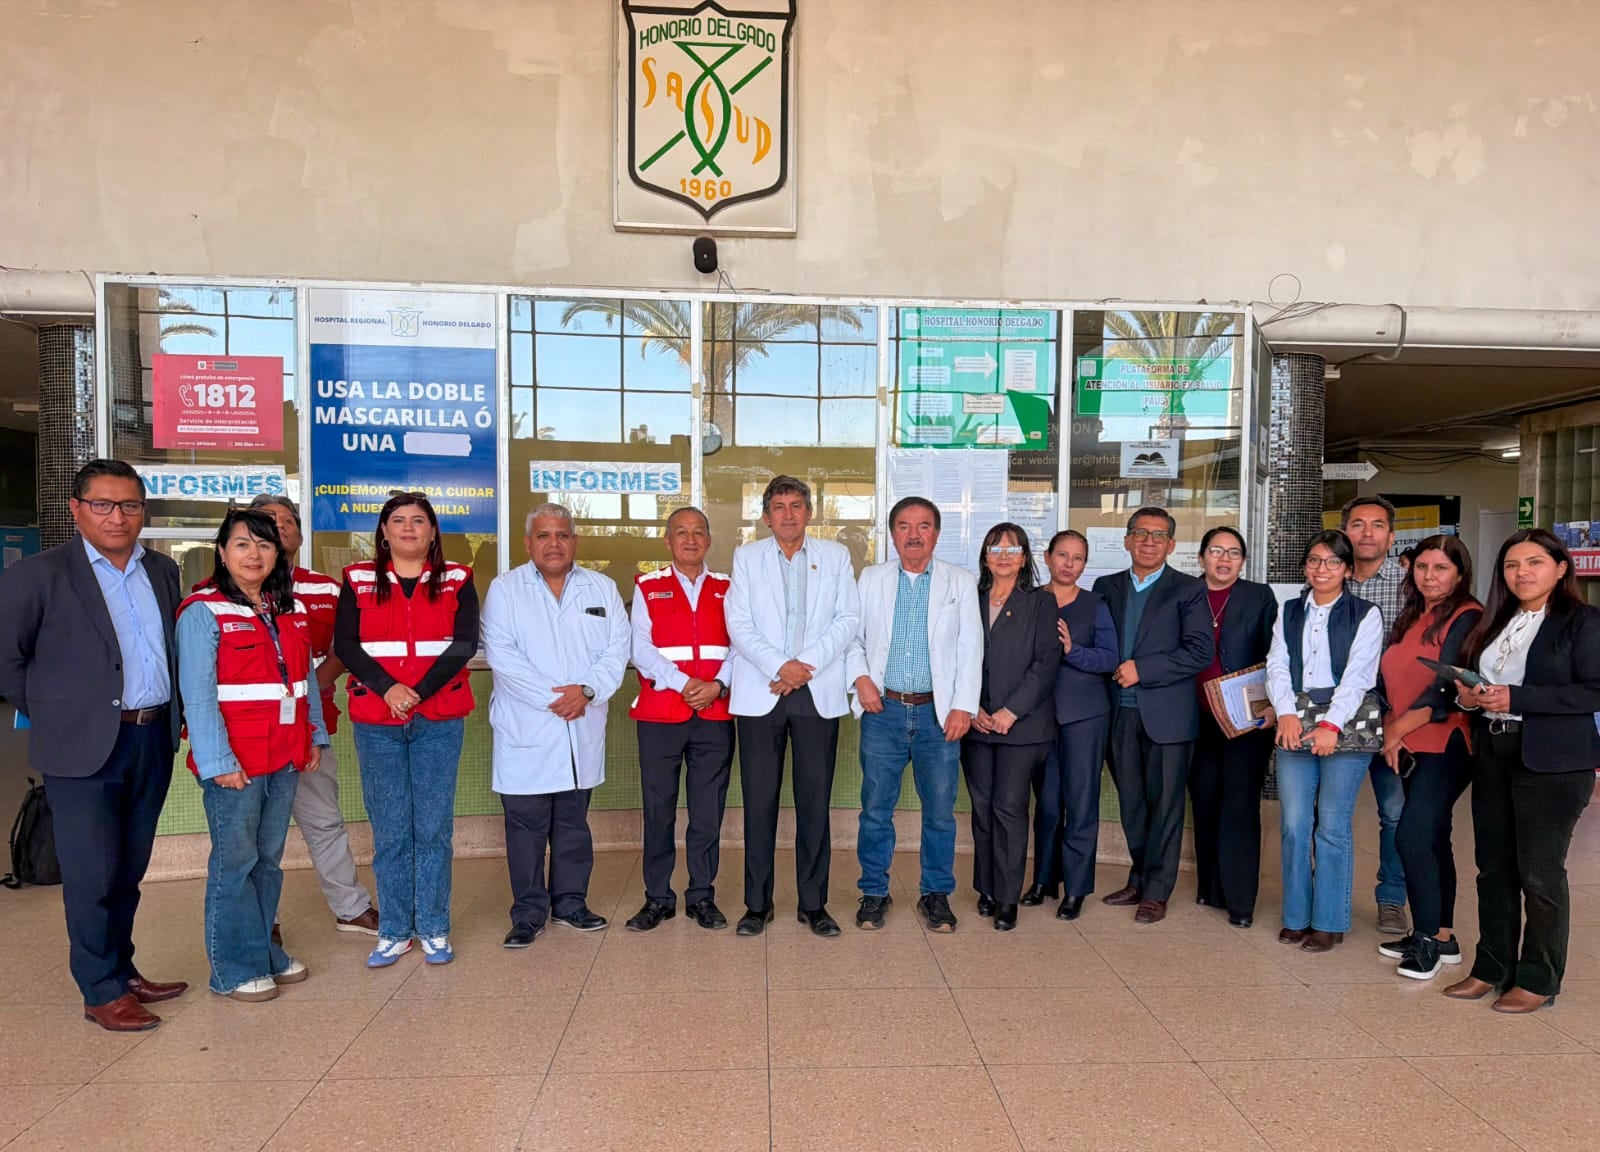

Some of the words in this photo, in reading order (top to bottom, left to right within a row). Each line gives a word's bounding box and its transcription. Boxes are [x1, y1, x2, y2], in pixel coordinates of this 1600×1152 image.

[640, 18, 701, 50] HONORIO
[707, 18, 776, 53] DELGADO
[679, 178, 732, 201] 1960
[314, 316, 348, 324] HOSPITAL
[350, 317, 386, 325] REGIONAL
[422, 319, 457, 327] HONORIO
[458, 321, 492, 329] DELGADO
[924, 316, 964, 326] HOSPITAL
[966, 317, 1002, 327] HONORIO
[1005, 317, 1044, 327] DELGADO
[1121, 364, 1175, 374] PLATAFORMA
[1177, 364, 1189, 374] DE
[317, 380, 365, 399] USA
[372, 381, 402, 399] LA
[409, 382, 486, 402] DOBLE
[1144, 380, 1180, 390] USUARIO
[193, 383, 256, 408] 1812
[315, 406, 468, 428] MASCARILLA
[474, 406, 492, 429] Ó
[342, 433, 397, 452] UNA
[142, 474, 283, 495] NFORMES
[532, 470, 679, 491] INFORMES
[446, 486, 495, 497] CUIDAR
[340, 503, 351, 513] A
[352, 503, 386, 513] NUES
[433, 504, 470, 515] MILIA!
